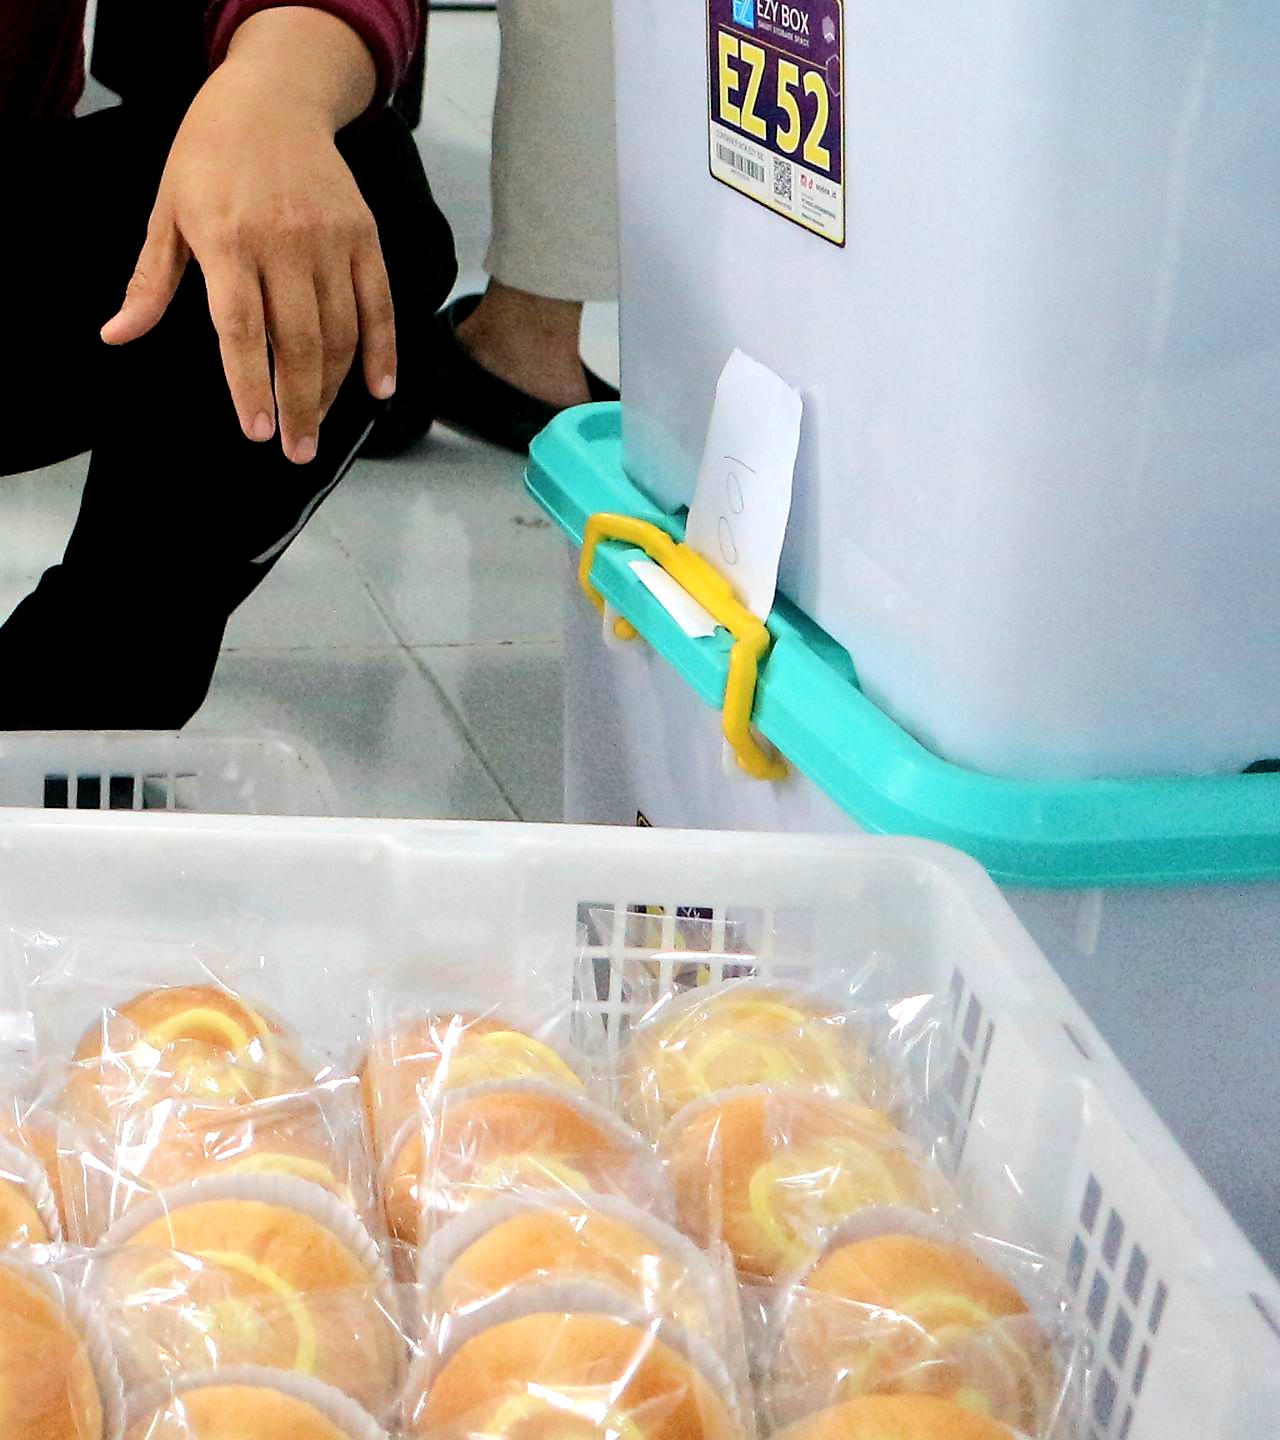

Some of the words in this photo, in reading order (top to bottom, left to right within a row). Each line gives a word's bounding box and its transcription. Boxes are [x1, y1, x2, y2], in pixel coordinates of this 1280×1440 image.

[781, 4, 810, 36] BOX
[718, 30, 767, 141] EZ
[776, 58, 831, 172] 52
